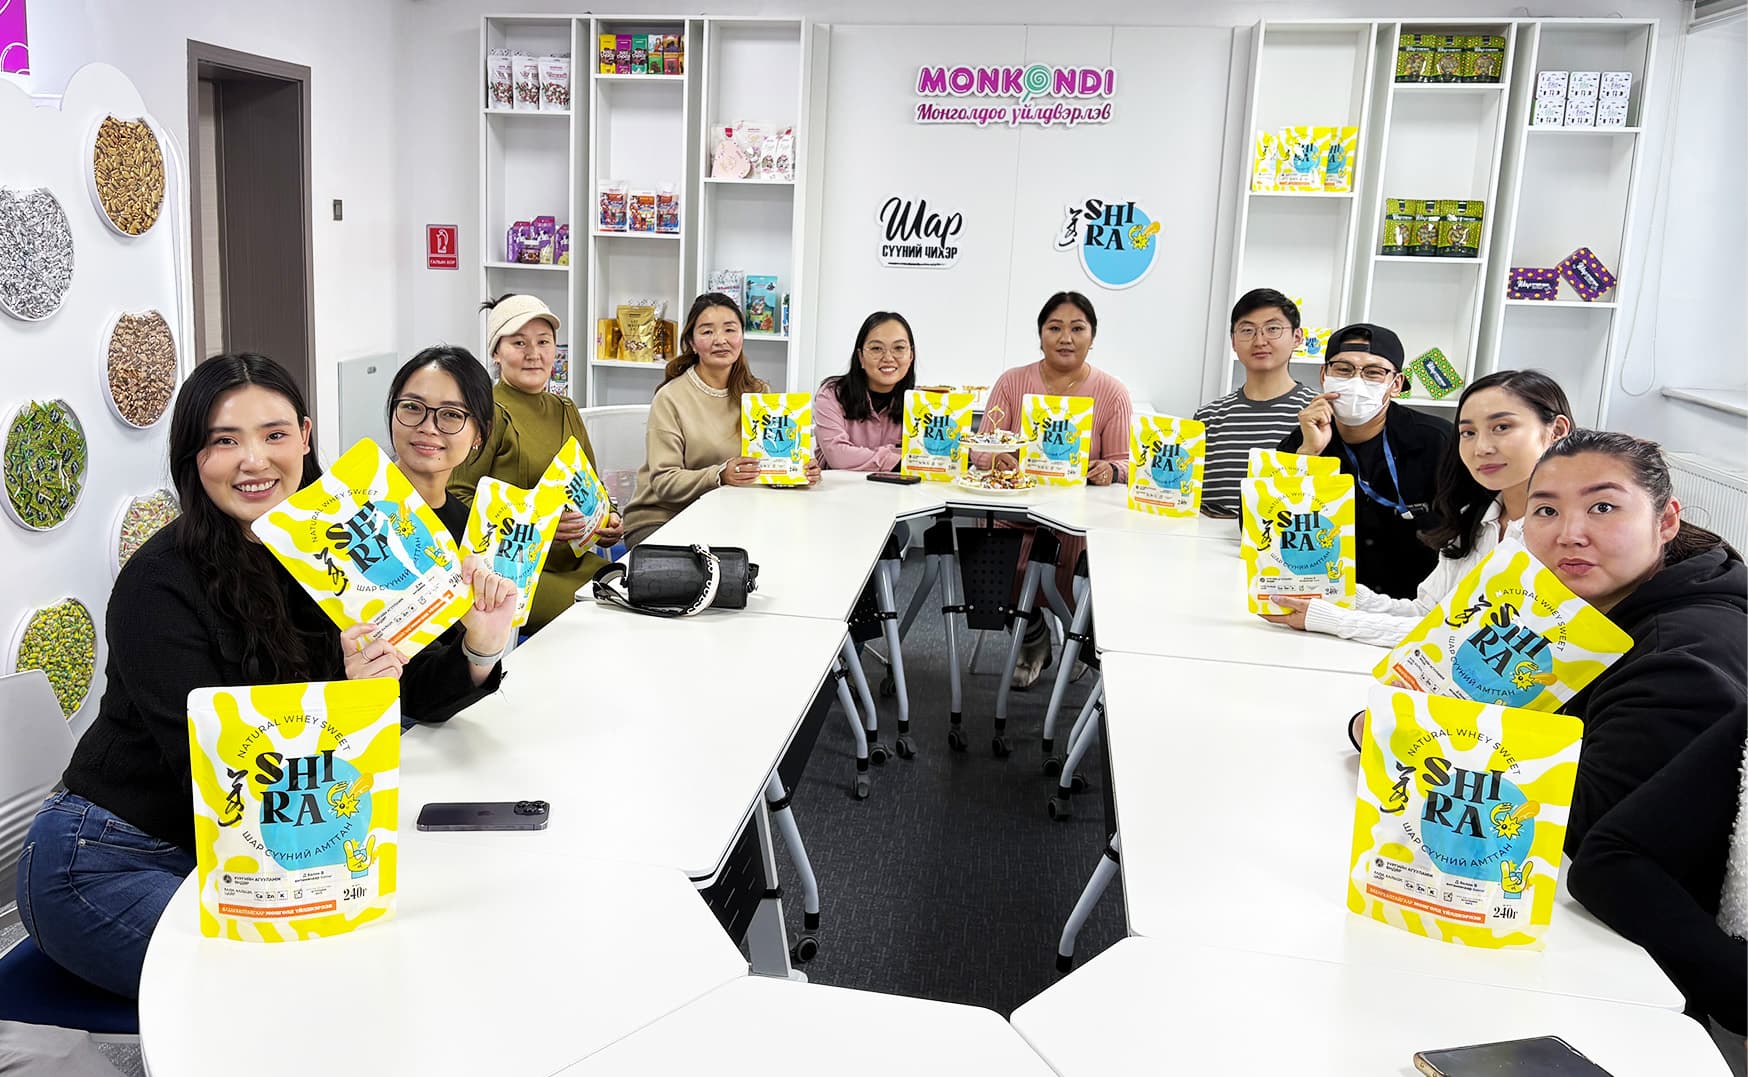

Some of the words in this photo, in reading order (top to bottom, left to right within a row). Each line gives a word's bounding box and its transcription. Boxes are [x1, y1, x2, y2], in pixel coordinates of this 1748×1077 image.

[918, 65, 1114, 98] MONKONDI
[917, 103, 1007, 124] Монголдоо
[1012, 103, 1112, 124] үйлдвэрлэв
[880, 197, 962, 250] Шар
[1084, 199, 1136, 227] SHI
[1085, 224, 1125, 250] RA
[882, 244, 922, 258] СҮҮНИЙ
[925, 246, 958, 259] ЧИХЭР
[924, 413, 950, 427] SHI
[1042, 417, 1069, 432] SHI
[925, 426, 945, 440] RA
[1043, 431, 1064, 445] RA
[1152, 440, 1180, 458] SHI
[1152, 455, 1175, 472] RA
[322, 492, 345, 508] WHEY
[347, 488, 379, 497] SWEET
[500, 517, 536, 543] SHI
[1277, 510, 1320, 532] SHI
[496, 538, 524, 563] RA
[1280, 531, 1316, 552] RA
[1540, 599, 1562, 620] WHEY
[1556, 621, 1567, 652] SWEET
[1467, 624, 1514, 678] RA
[1476, 684, 1516, 697] АМТТАН
[236, 719, 281, 759] NATURAL
[283, 714, 320, 725] WHEY
[320, 720, 351, 752] SWEET
[1407, 728, 1453, 757] NATURAL
[1456, 728, 1492, 744] WHEY
[1493, 742, 1521, 776] SWEET
[255, 749, 337, 792] SHI
[1422, 756, 1505, 804] SHI
[260, 791, 327, 827] RA
[1422, 790, 1487, 839] RA
[241, 830, 265, 852] ШАР
[264, 848, 312, 861] СҮҮНИЙ
[314, 822, 353, 855] АМТТАН
[1402, 822, 1422, 845] ШАР
[1421, 842, 1467, 867] СҮҮНИЙ
[1470, 843, 1513, 867] АМТТАН
[343, 886, 368, 901] 240г
[1492, 906, 1518, 920] 240г
